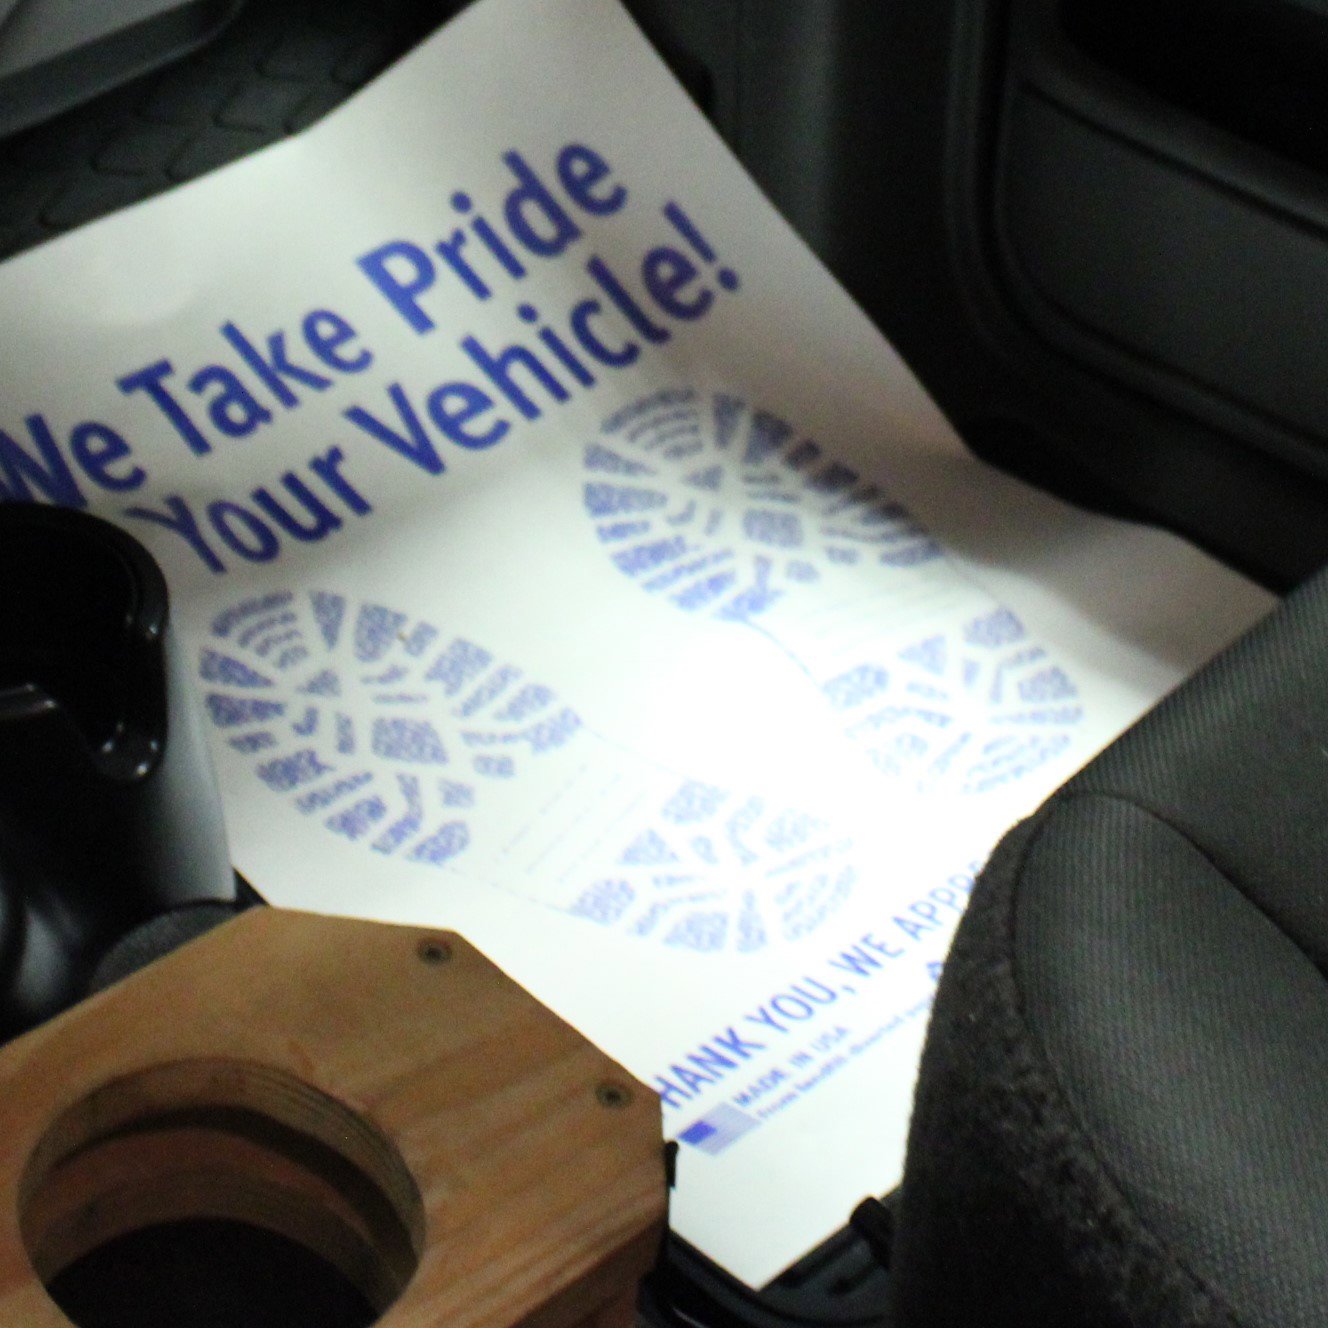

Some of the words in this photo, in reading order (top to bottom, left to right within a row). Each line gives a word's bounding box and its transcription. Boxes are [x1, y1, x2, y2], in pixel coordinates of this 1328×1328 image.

[116, 308, 374, 457] Take
[355, 143, 629, 336] Pride
[122, 446, 373, 576] Your
[343, 201, 741, 478] Vehicle!
[654, 1026, 768, 1110] HANK
[744, 975, 858, 1035] YOU,
[827, 932, 905, 978] WE
